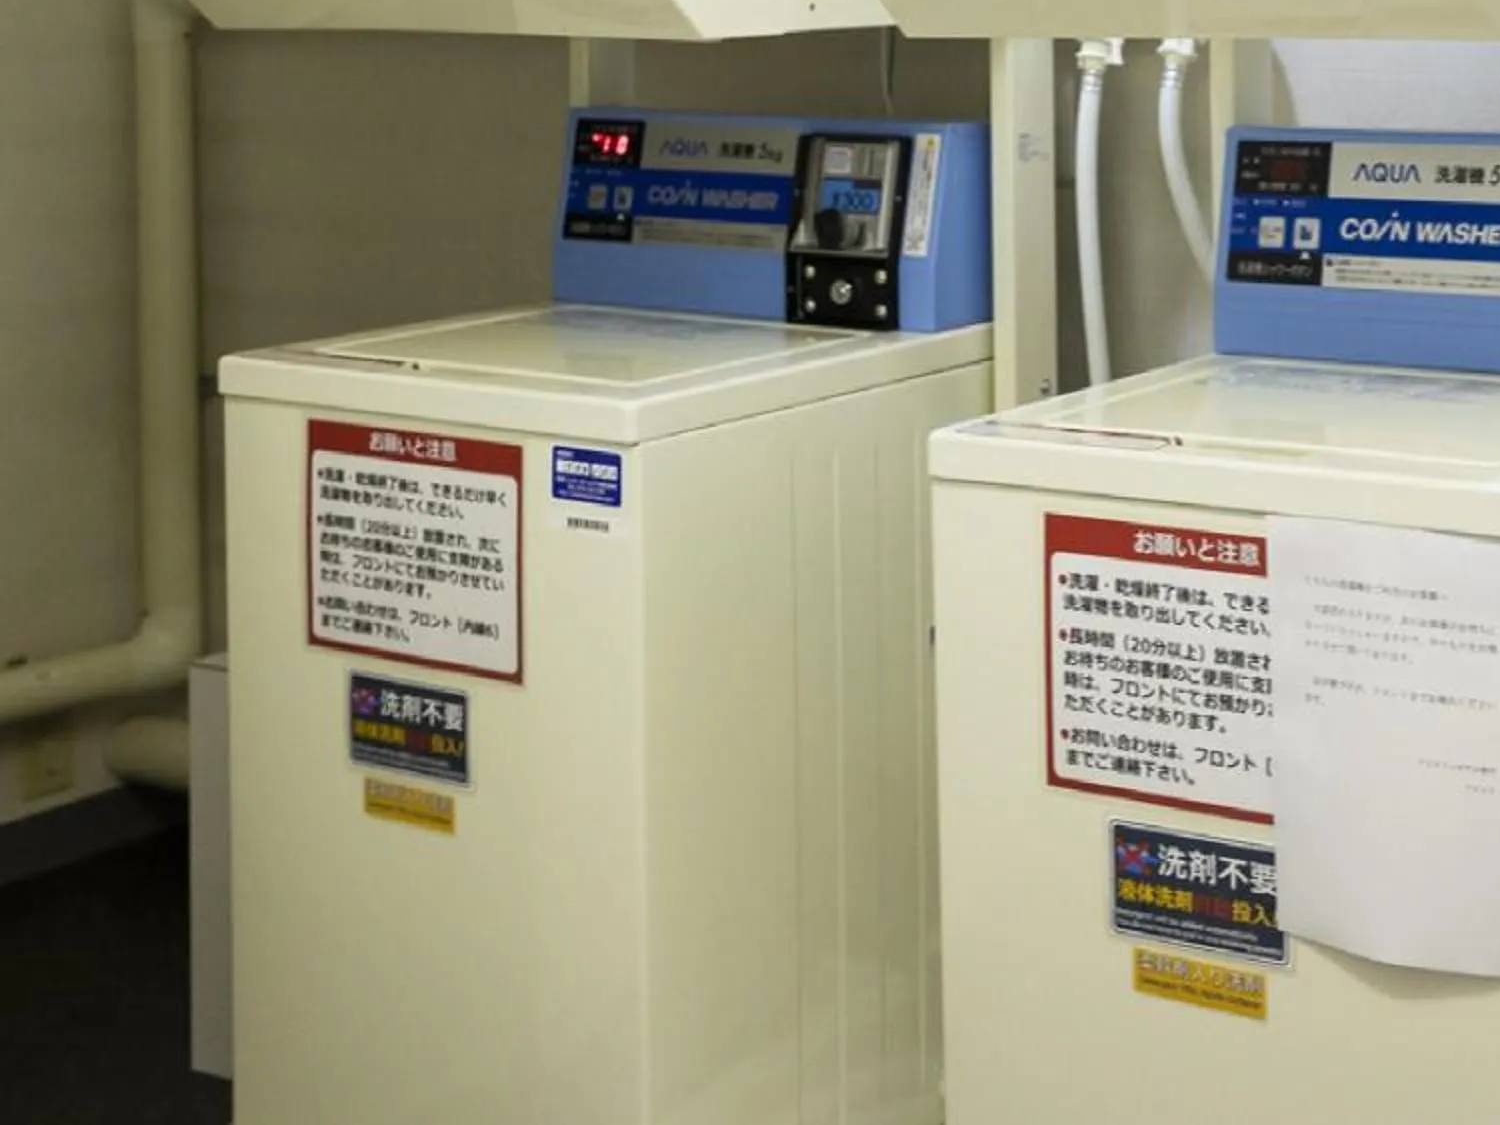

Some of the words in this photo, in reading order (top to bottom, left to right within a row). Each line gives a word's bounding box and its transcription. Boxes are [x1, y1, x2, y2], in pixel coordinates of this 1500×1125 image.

[658, 136, 709, 158] AQUA
[1352, 163, 1422, 184] AQUA
[1133, 531, 1261, 567] お願いと注意
[1063, 672, 1274, 718] 時は、フロントにてお預かり
[1064, 694, 1227, 734] ただくことがあります。
[1157, 843, 1277, 896] 洗剤不要
